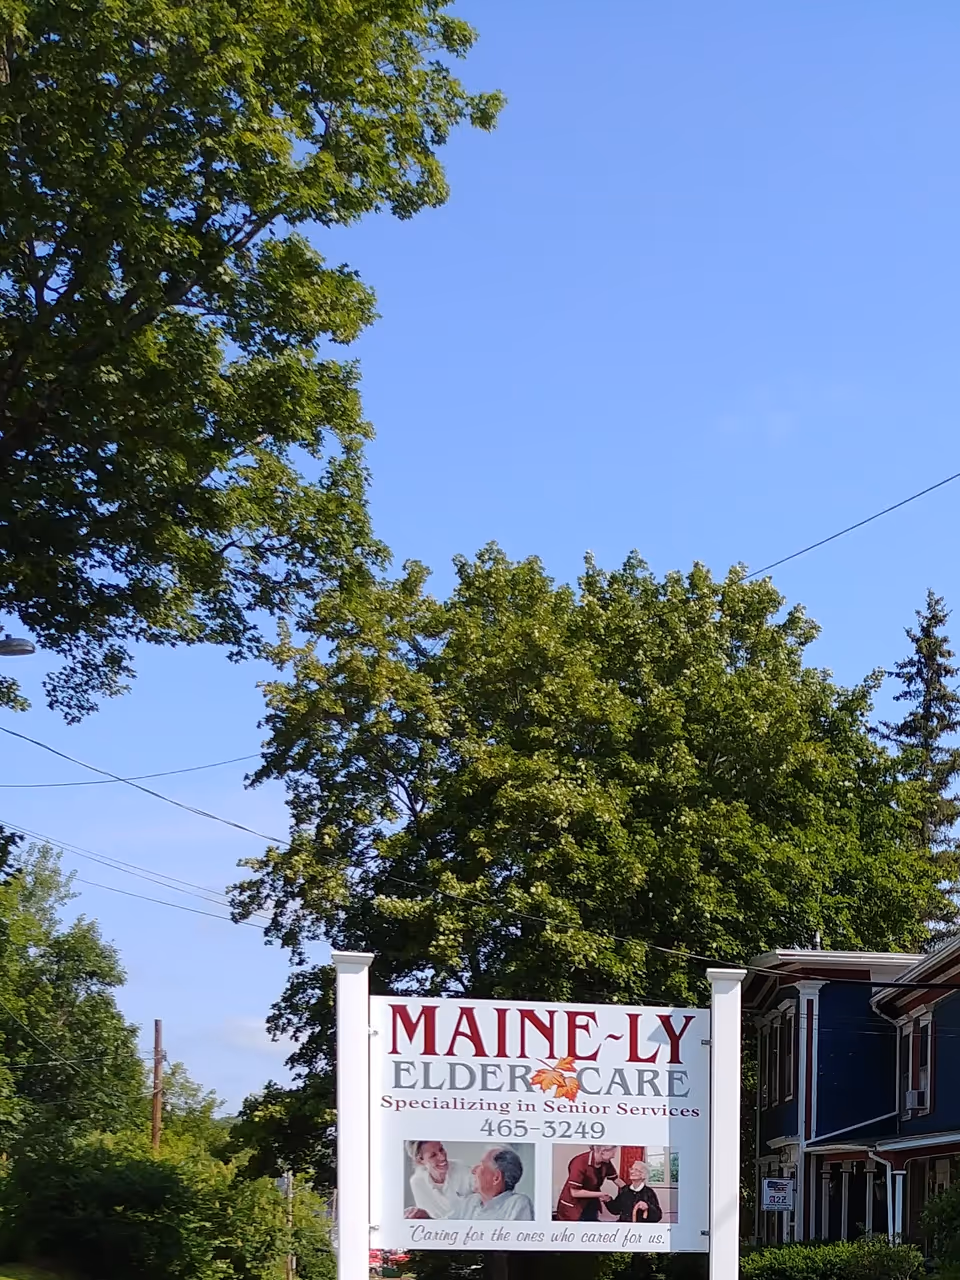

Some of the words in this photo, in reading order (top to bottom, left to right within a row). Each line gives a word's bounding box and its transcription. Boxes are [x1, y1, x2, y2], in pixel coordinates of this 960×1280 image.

[391, 1060, 534, 1093] ELDER
[576, 1066, 691, 1098] CARE
[380, 1094, 511, 1116] Specializing
[516, 1100, 536, 1113] in
[543, 1100, 611, 1115] Senior
[616, 1102, 700, 1118] Services
[479, 1118, 606, 1139] 465-3249
[463, 1226, 485, 1245] for
[490, 1226, 511, 1243] the
[515, 1230, 545, 1243] ones
[550, 1228, 576, 1244] who
[580, 1228, 617, 1245] cared
[621, 1228, 643, 1247] for
